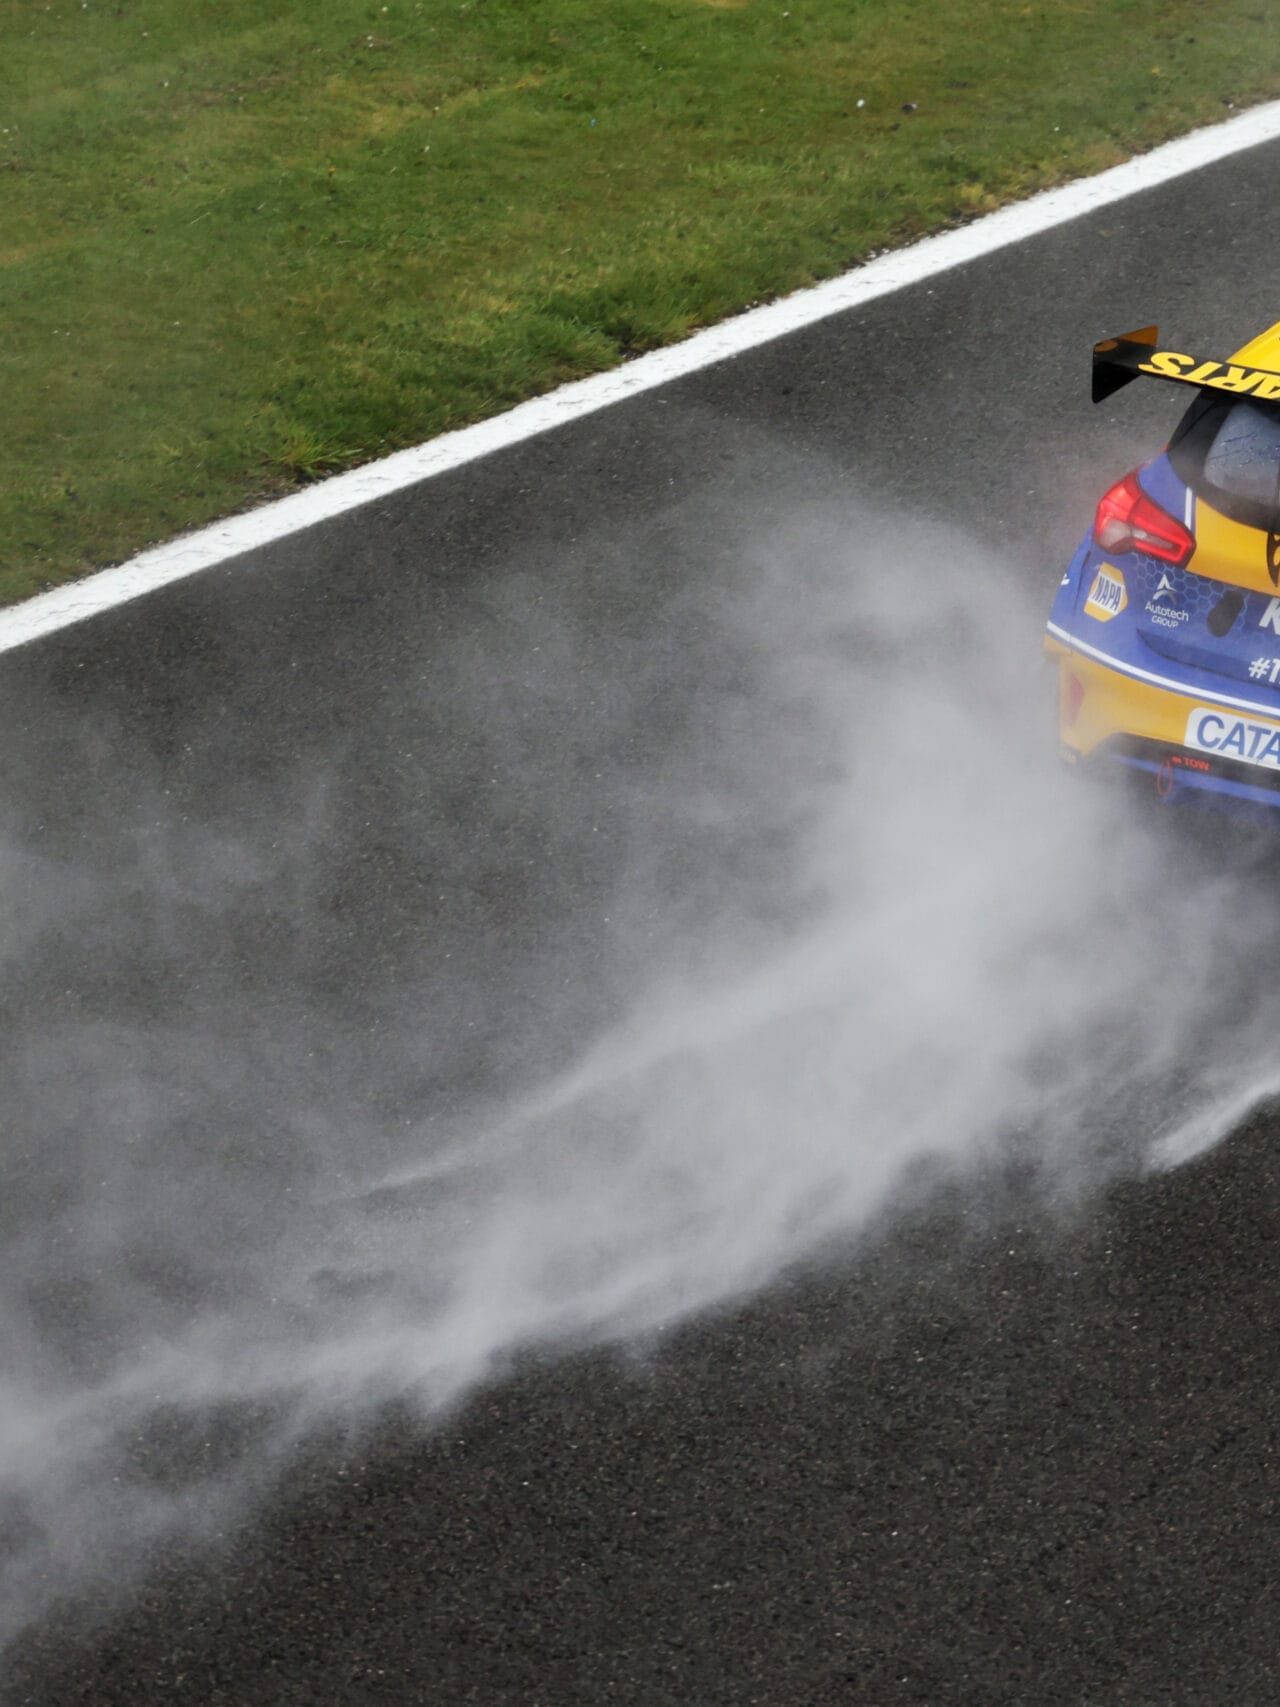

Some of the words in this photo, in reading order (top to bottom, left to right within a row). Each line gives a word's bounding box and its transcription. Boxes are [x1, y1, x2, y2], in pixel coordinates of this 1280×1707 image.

[1093, 576, 1122, 612] NAPA
[1144, 602, 1189, 623] Autotech
[1151, 615, 1179, 628] GROUP
[1184, 757, 1211, 772] TOW
